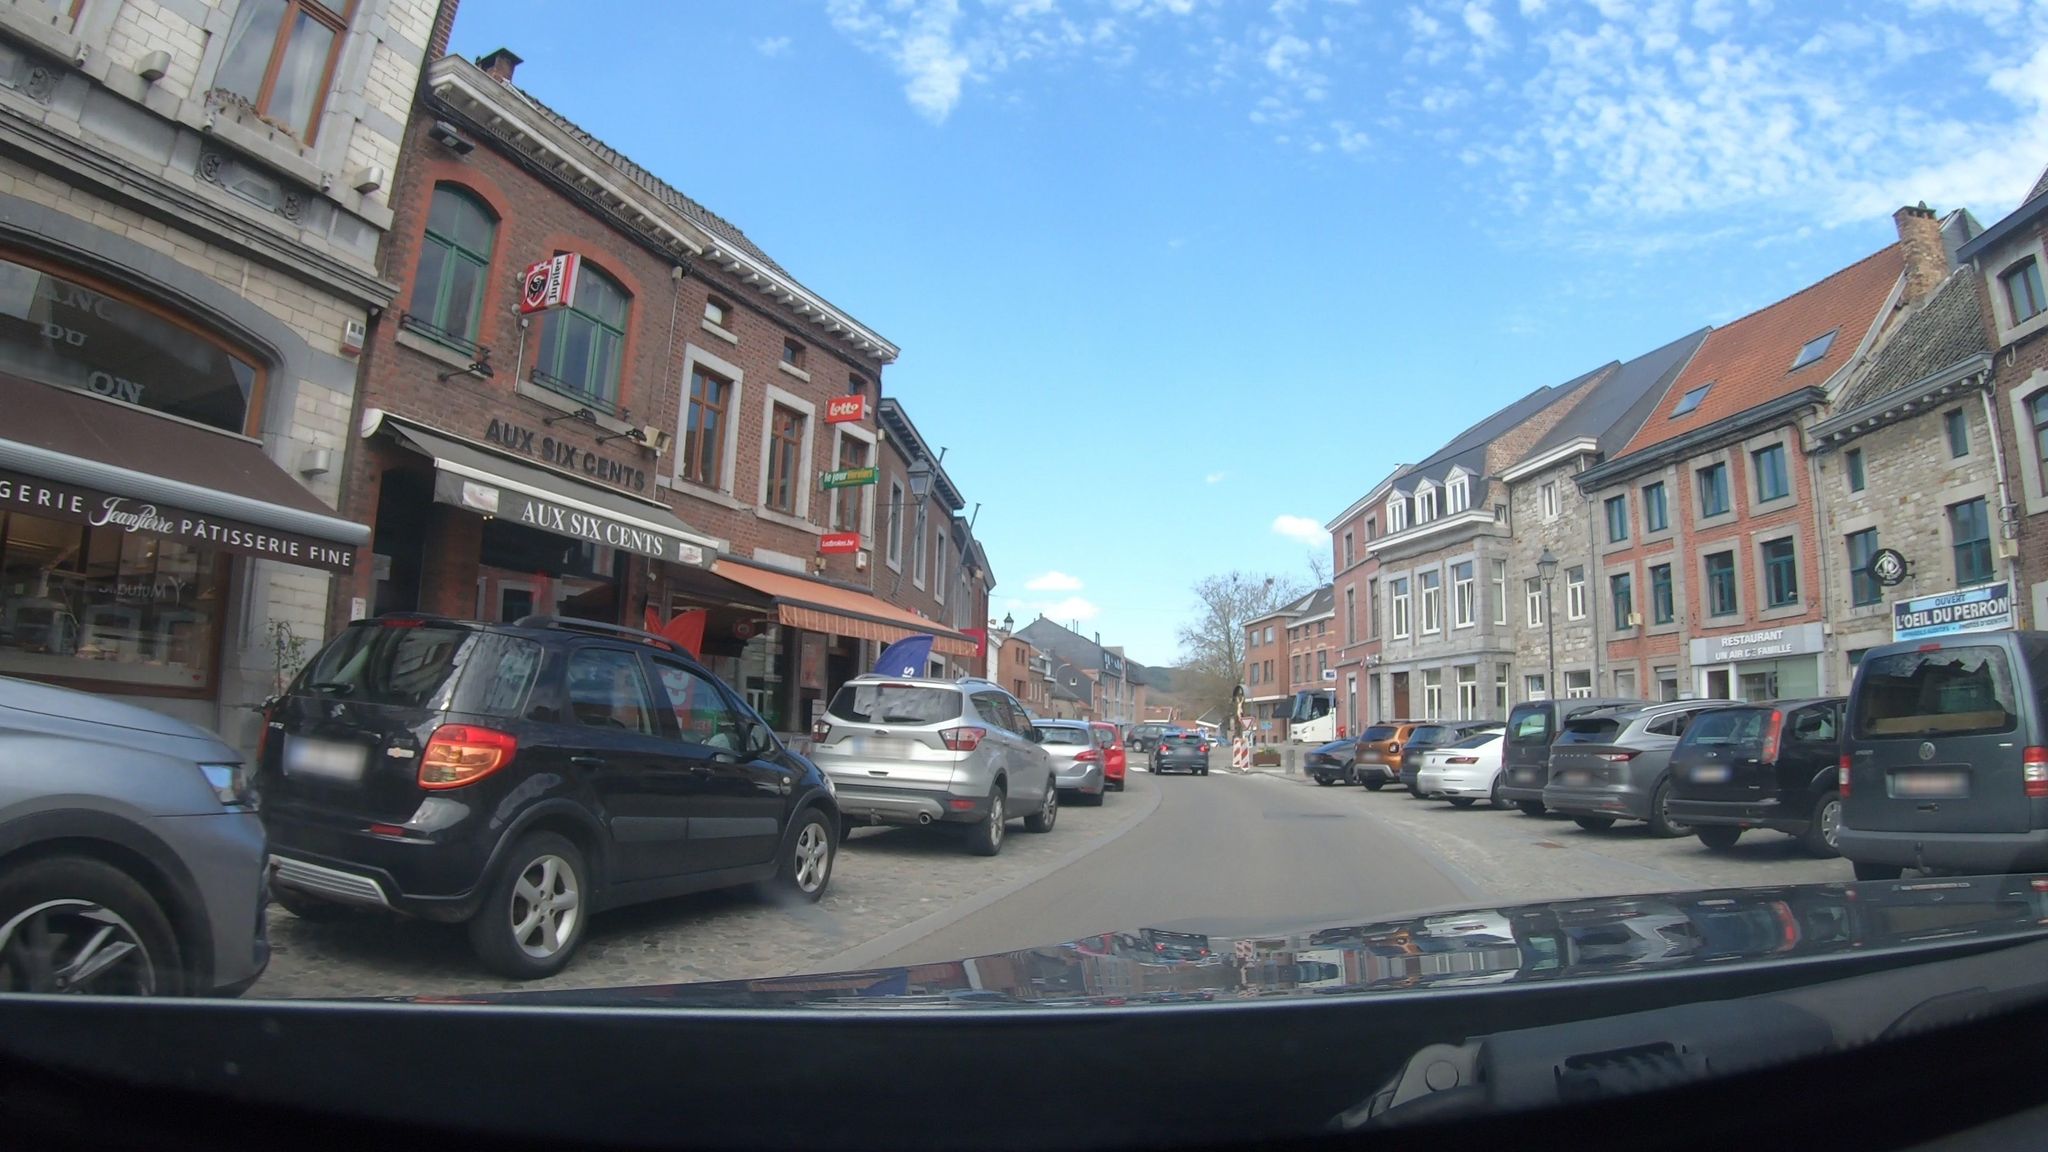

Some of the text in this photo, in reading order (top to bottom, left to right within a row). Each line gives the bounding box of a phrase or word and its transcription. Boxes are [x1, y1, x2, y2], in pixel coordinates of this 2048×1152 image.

[549, 258, 562, 301] Jupiler
[484, 418, 645, 491] AUX SIX CENTS
[181, 519, 299, 557] PÂTISSERIE
[310, 546, 351, 567] FINE
[521, 501, 662, 556] AUX SIX CENTS
[1896, 597, 2008, 629] L'OEIL DU PERRON
[1935, 594, 1966, 606] OUVERT
[1721, 630, 1783, 647] RESTAURANT
[1729, 649, 1743, 659] AIR
[1757, 643, 1792, 655] FAMILLE
